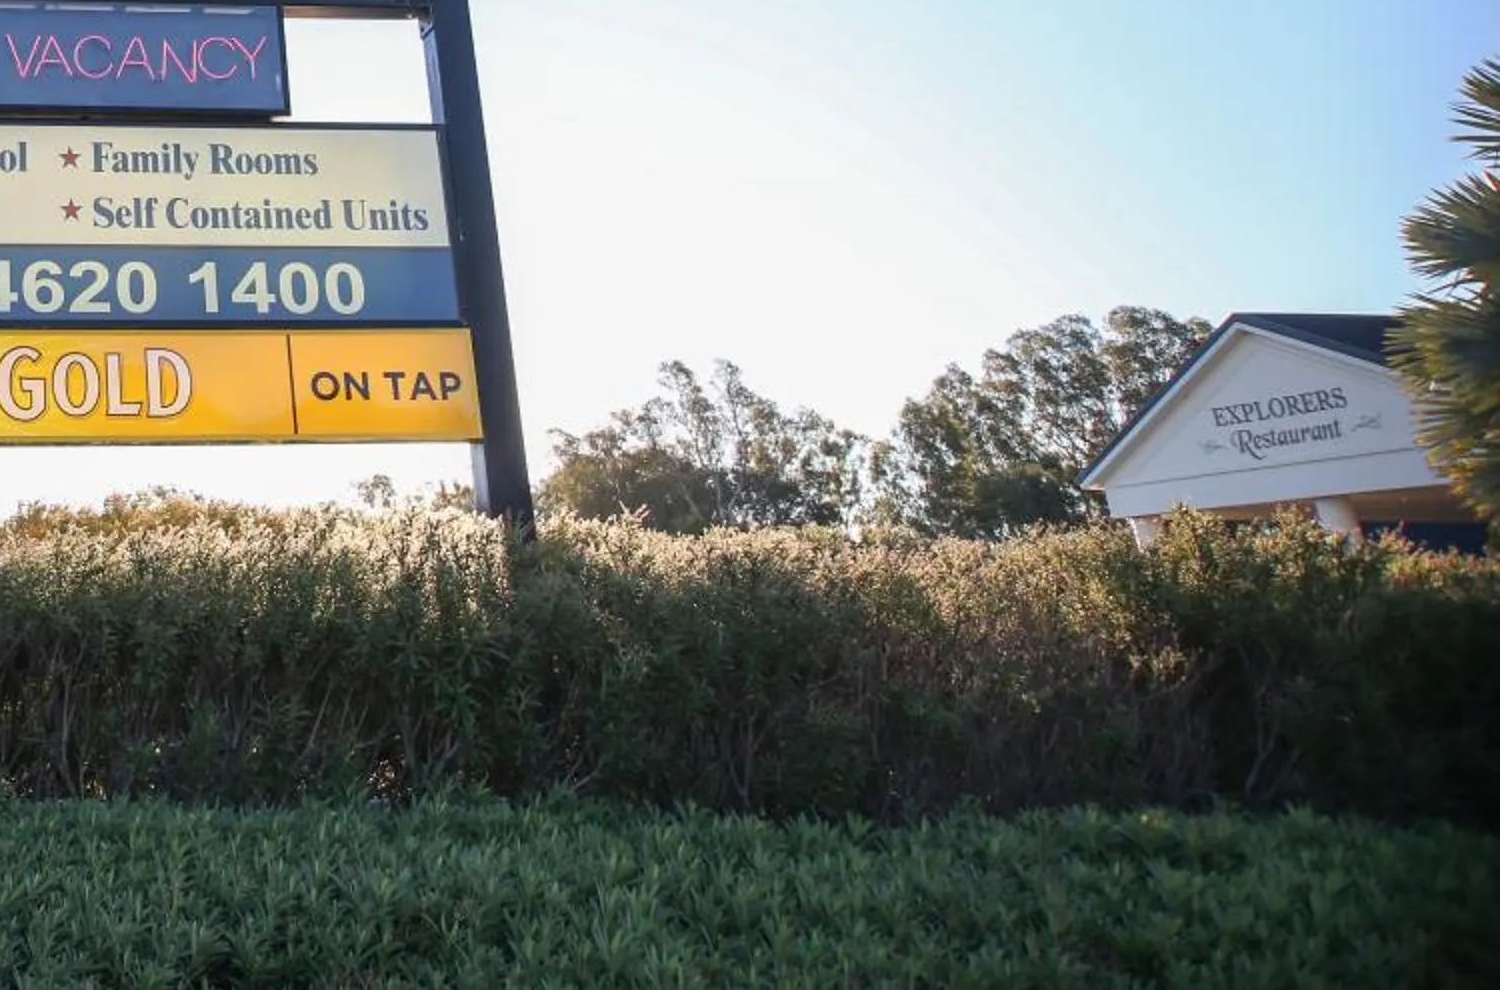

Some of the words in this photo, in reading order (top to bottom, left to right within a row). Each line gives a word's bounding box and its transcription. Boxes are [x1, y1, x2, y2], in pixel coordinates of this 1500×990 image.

[5, 33, 268, 83] VACANCY
[92, 141, 199, 180] Family
[209, 144, 319, 175] Rooms
[93, 197, 158, 229] Self
[166, 197, 333, 230] Contained
[342, 199, 430, 231] Units
[189, 261, 365, 314] 1400
[310, 371, 370, 401] ON
[383, 371, 462, 401] TAP
[1212, 387, 1349, 428] EXPLORERS
[1231, 417, 1343, 461] Restaurant
